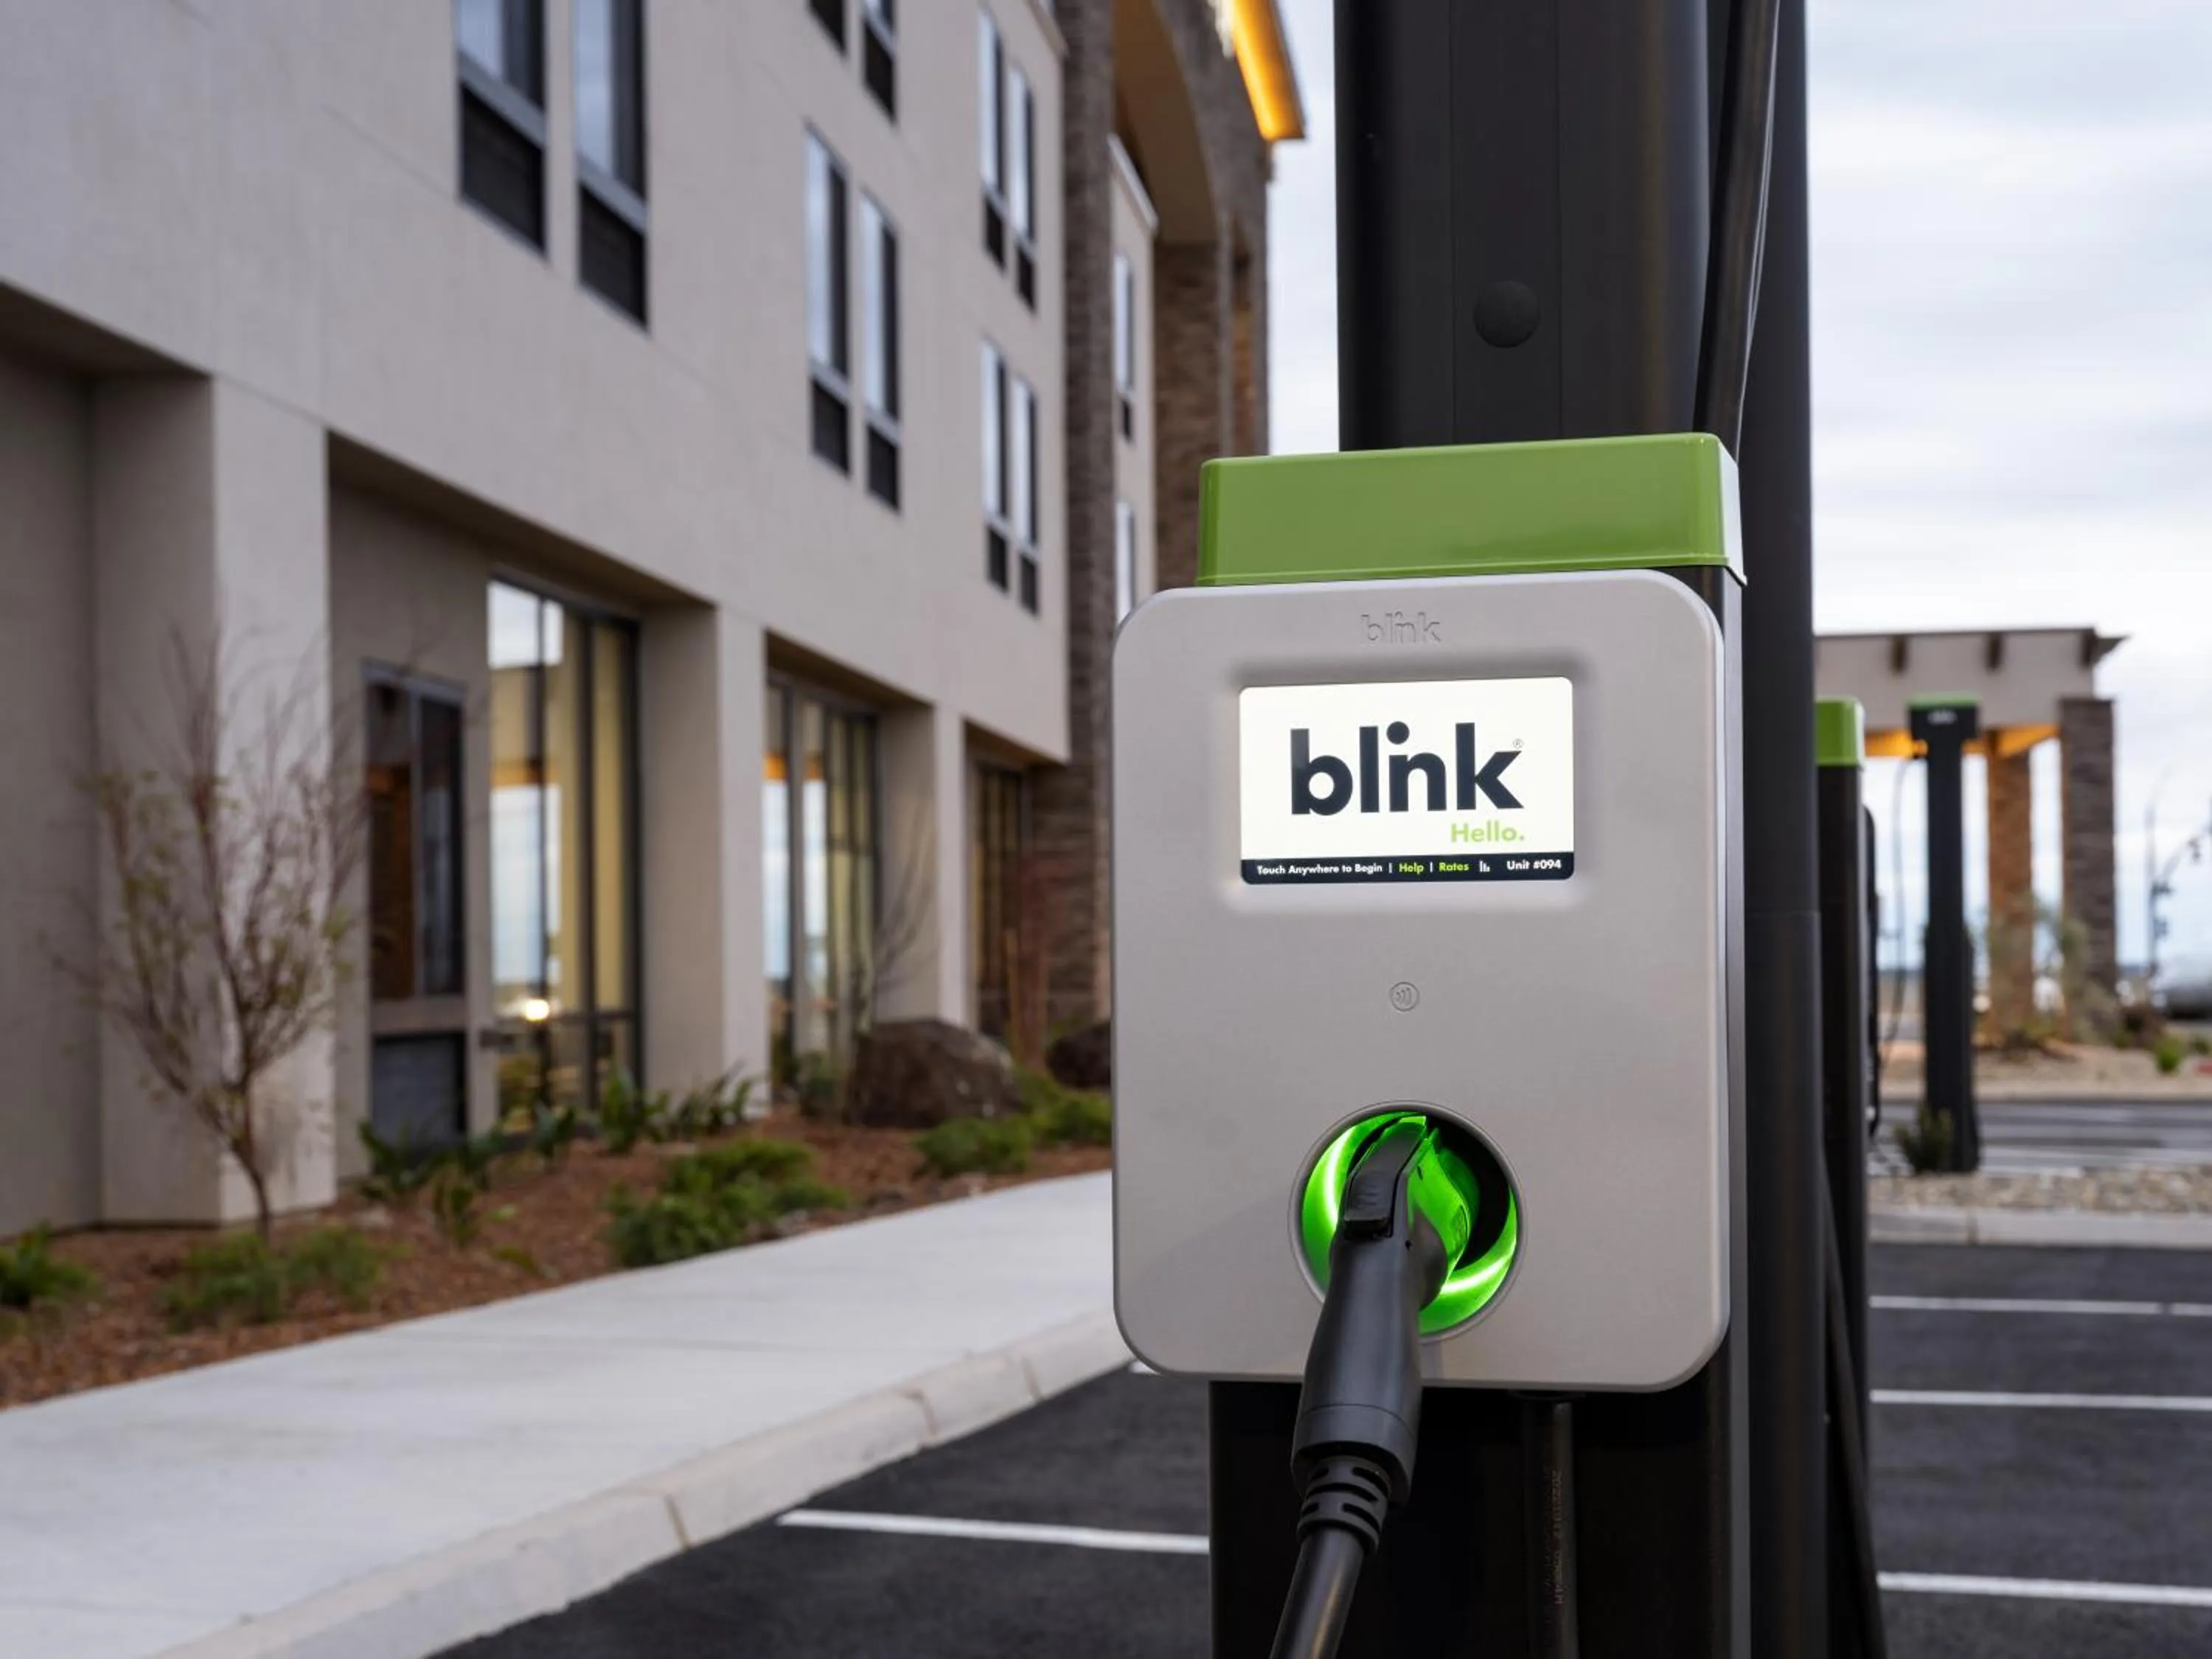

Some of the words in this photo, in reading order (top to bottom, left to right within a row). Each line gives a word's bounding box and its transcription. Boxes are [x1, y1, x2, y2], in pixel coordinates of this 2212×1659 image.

[1361, 611, 1442, 644] blink
[1290, 721, 1524, 815] blink
[1451, 820, 1525, 843] Hello.
[1256, 864, 1285, 875] Touch
[1288, 863, 1339, 877] Anywhere
[1342, 864, 1352, 874] to
[1354, 863, 1382, 875] Begin
[1399, 862, 1424, 875] Help
[1439, 861, 1470, 872] Rates
[1506, 859, 1530, 871] Unit
[1533, 858, 1562, 871] #094
